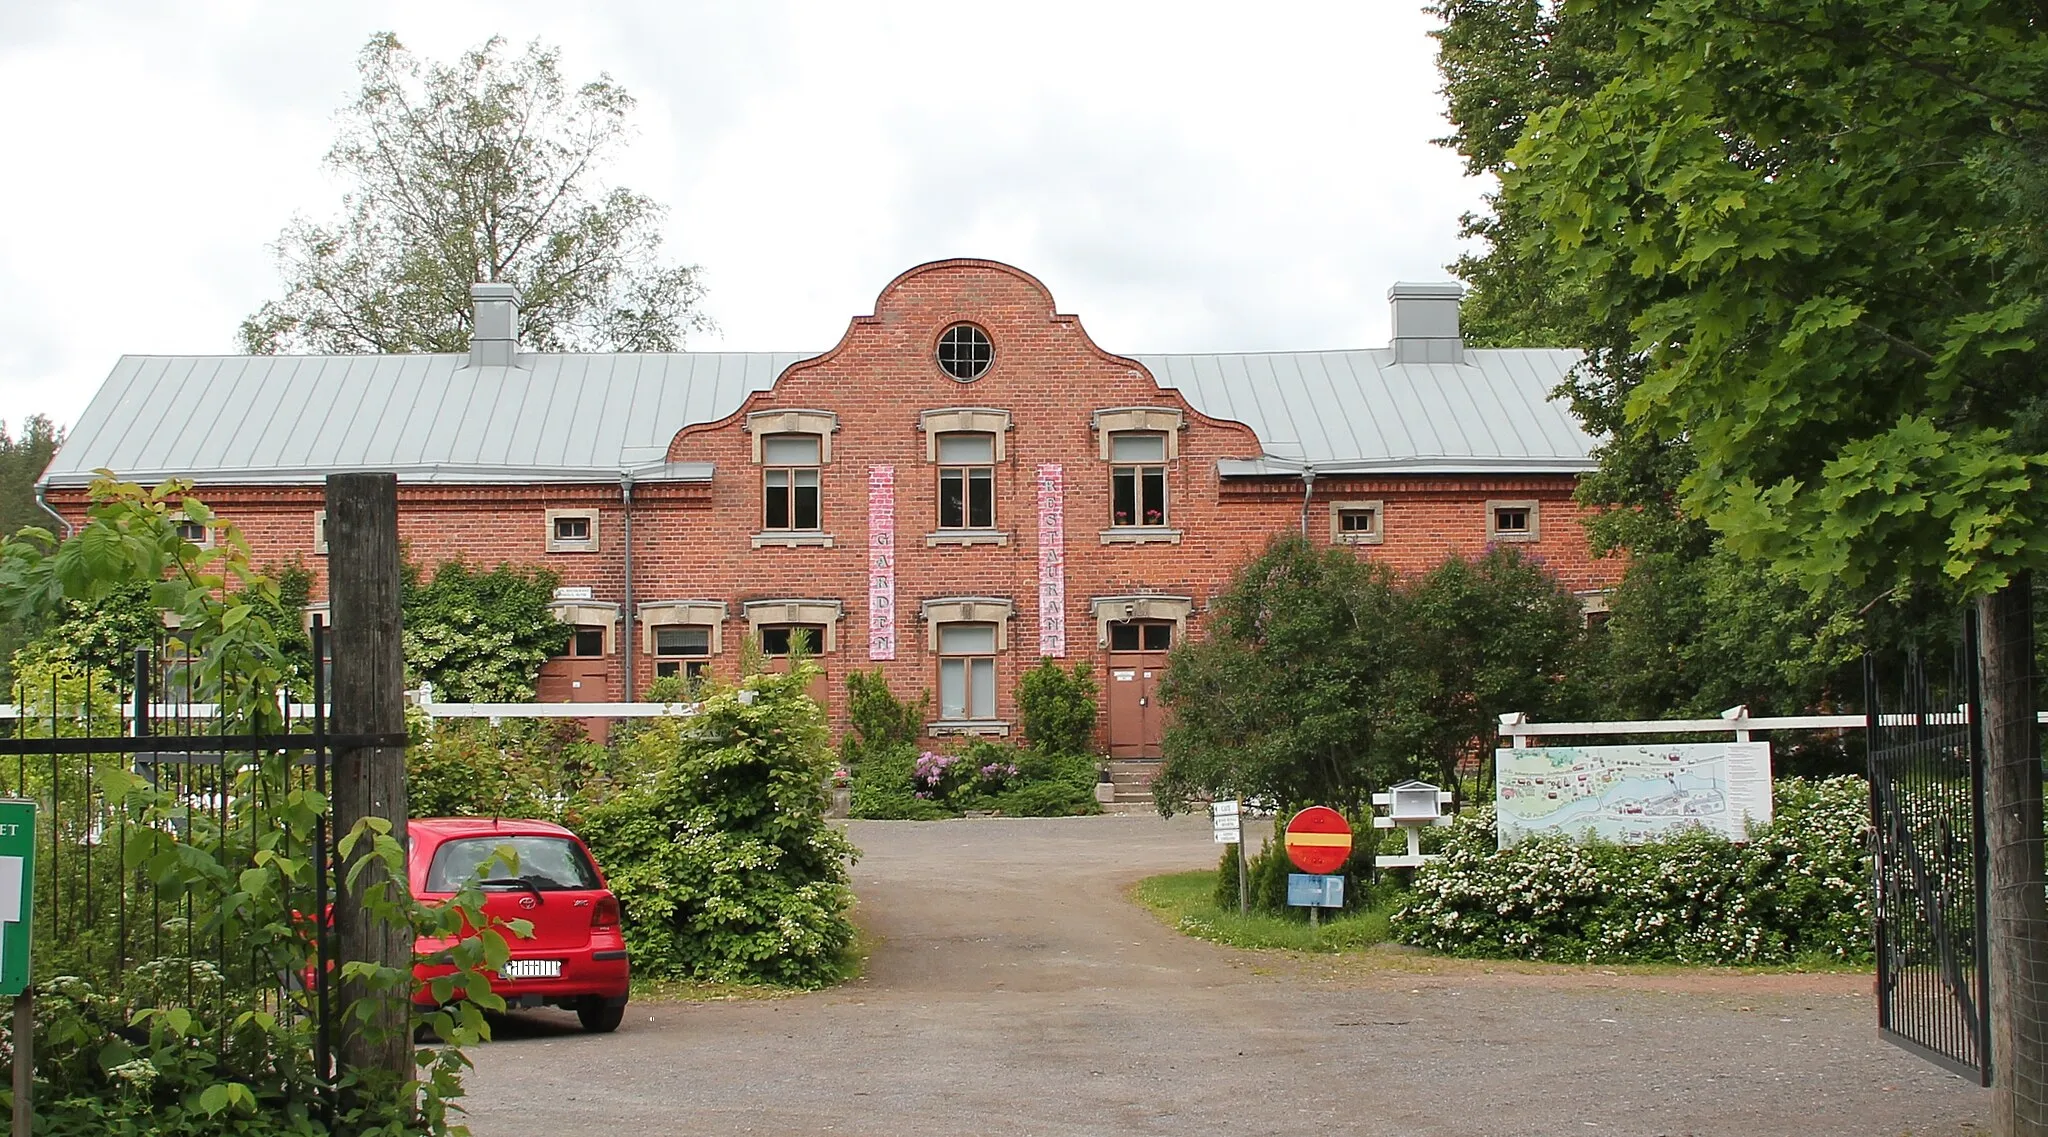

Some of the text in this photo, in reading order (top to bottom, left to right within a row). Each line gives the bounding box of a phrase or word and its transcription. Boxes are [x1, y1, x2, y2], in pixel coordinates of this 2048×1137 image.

[874, 532, 890, 649] GARDEN
[1044, 479, 1061, 648] RESTAURANT
[1326, 877, 1344, 906] P
